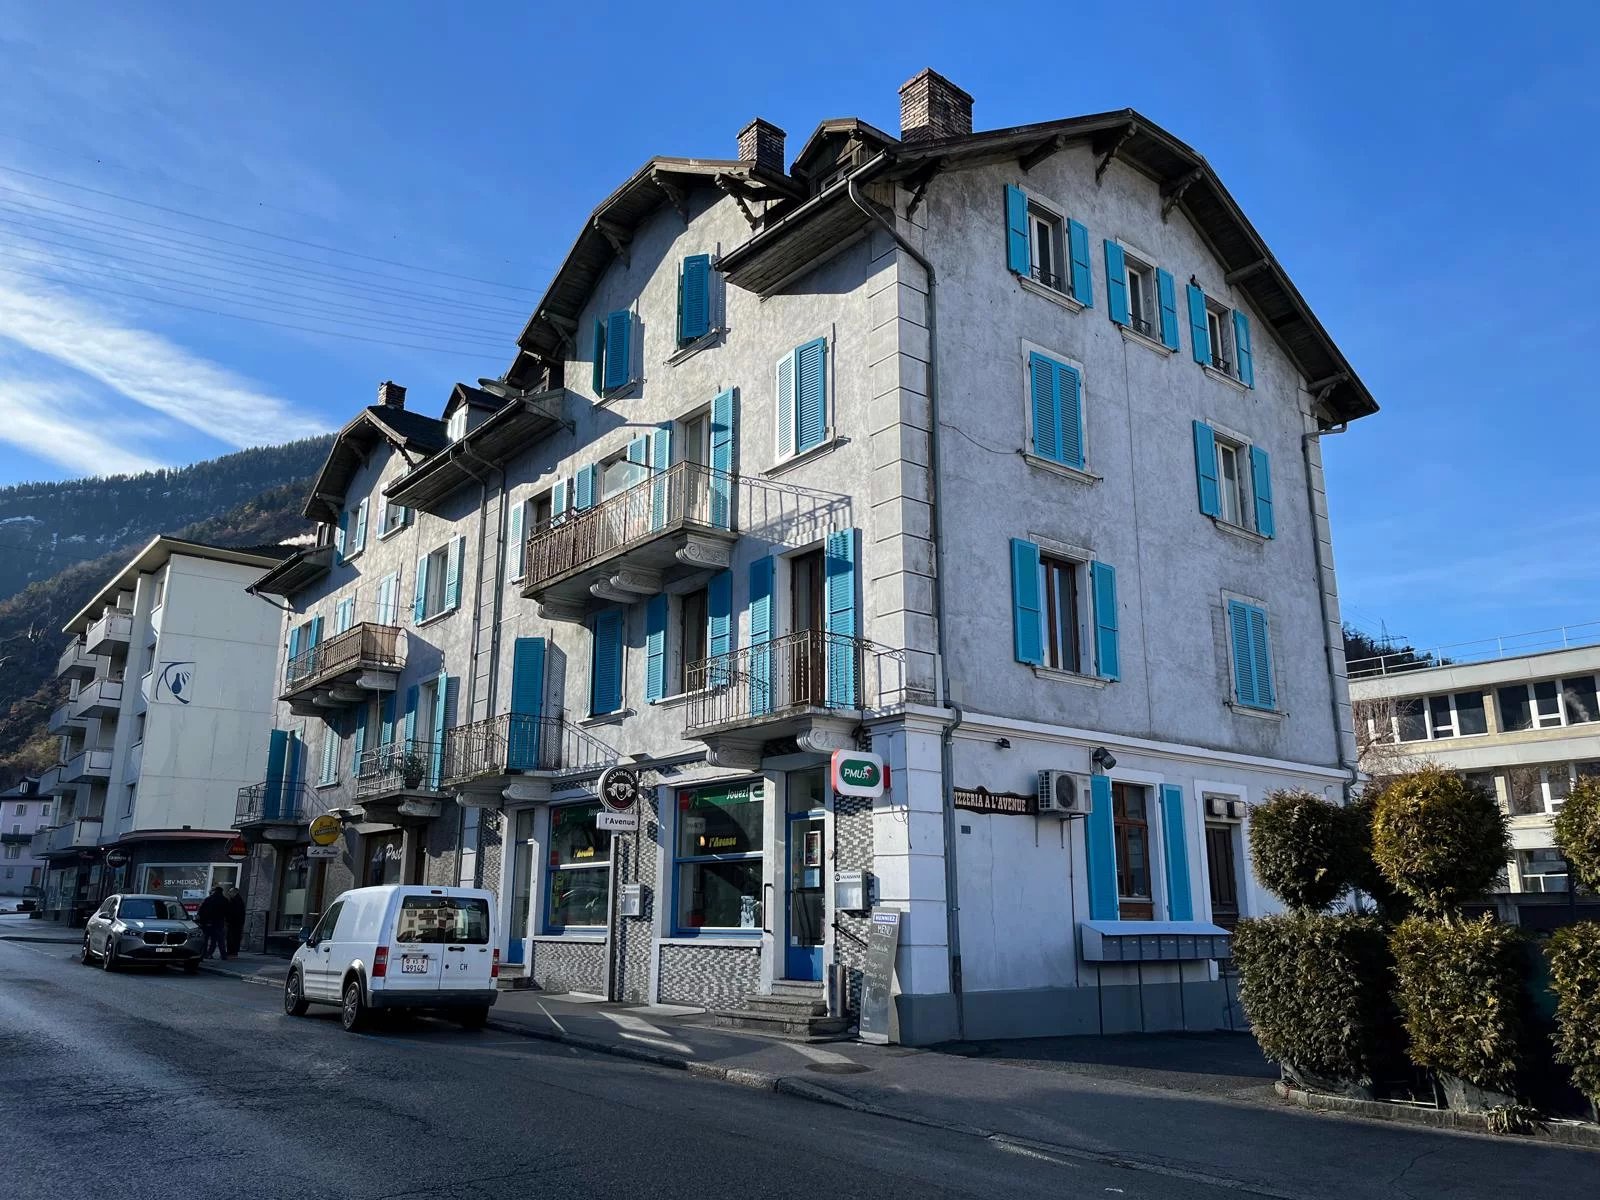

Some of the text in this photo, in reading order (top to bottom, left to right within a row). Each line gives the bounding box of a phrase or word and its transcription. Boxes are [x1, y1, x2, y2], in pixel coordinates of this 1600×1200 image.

[844, 768, 863, 779] PMU
[954, 791, 1026, 812] IZZERIA A L'AVENUE
[605, 817, 635, 826] l'Avenue
[459, 963, 468, 971] CH
